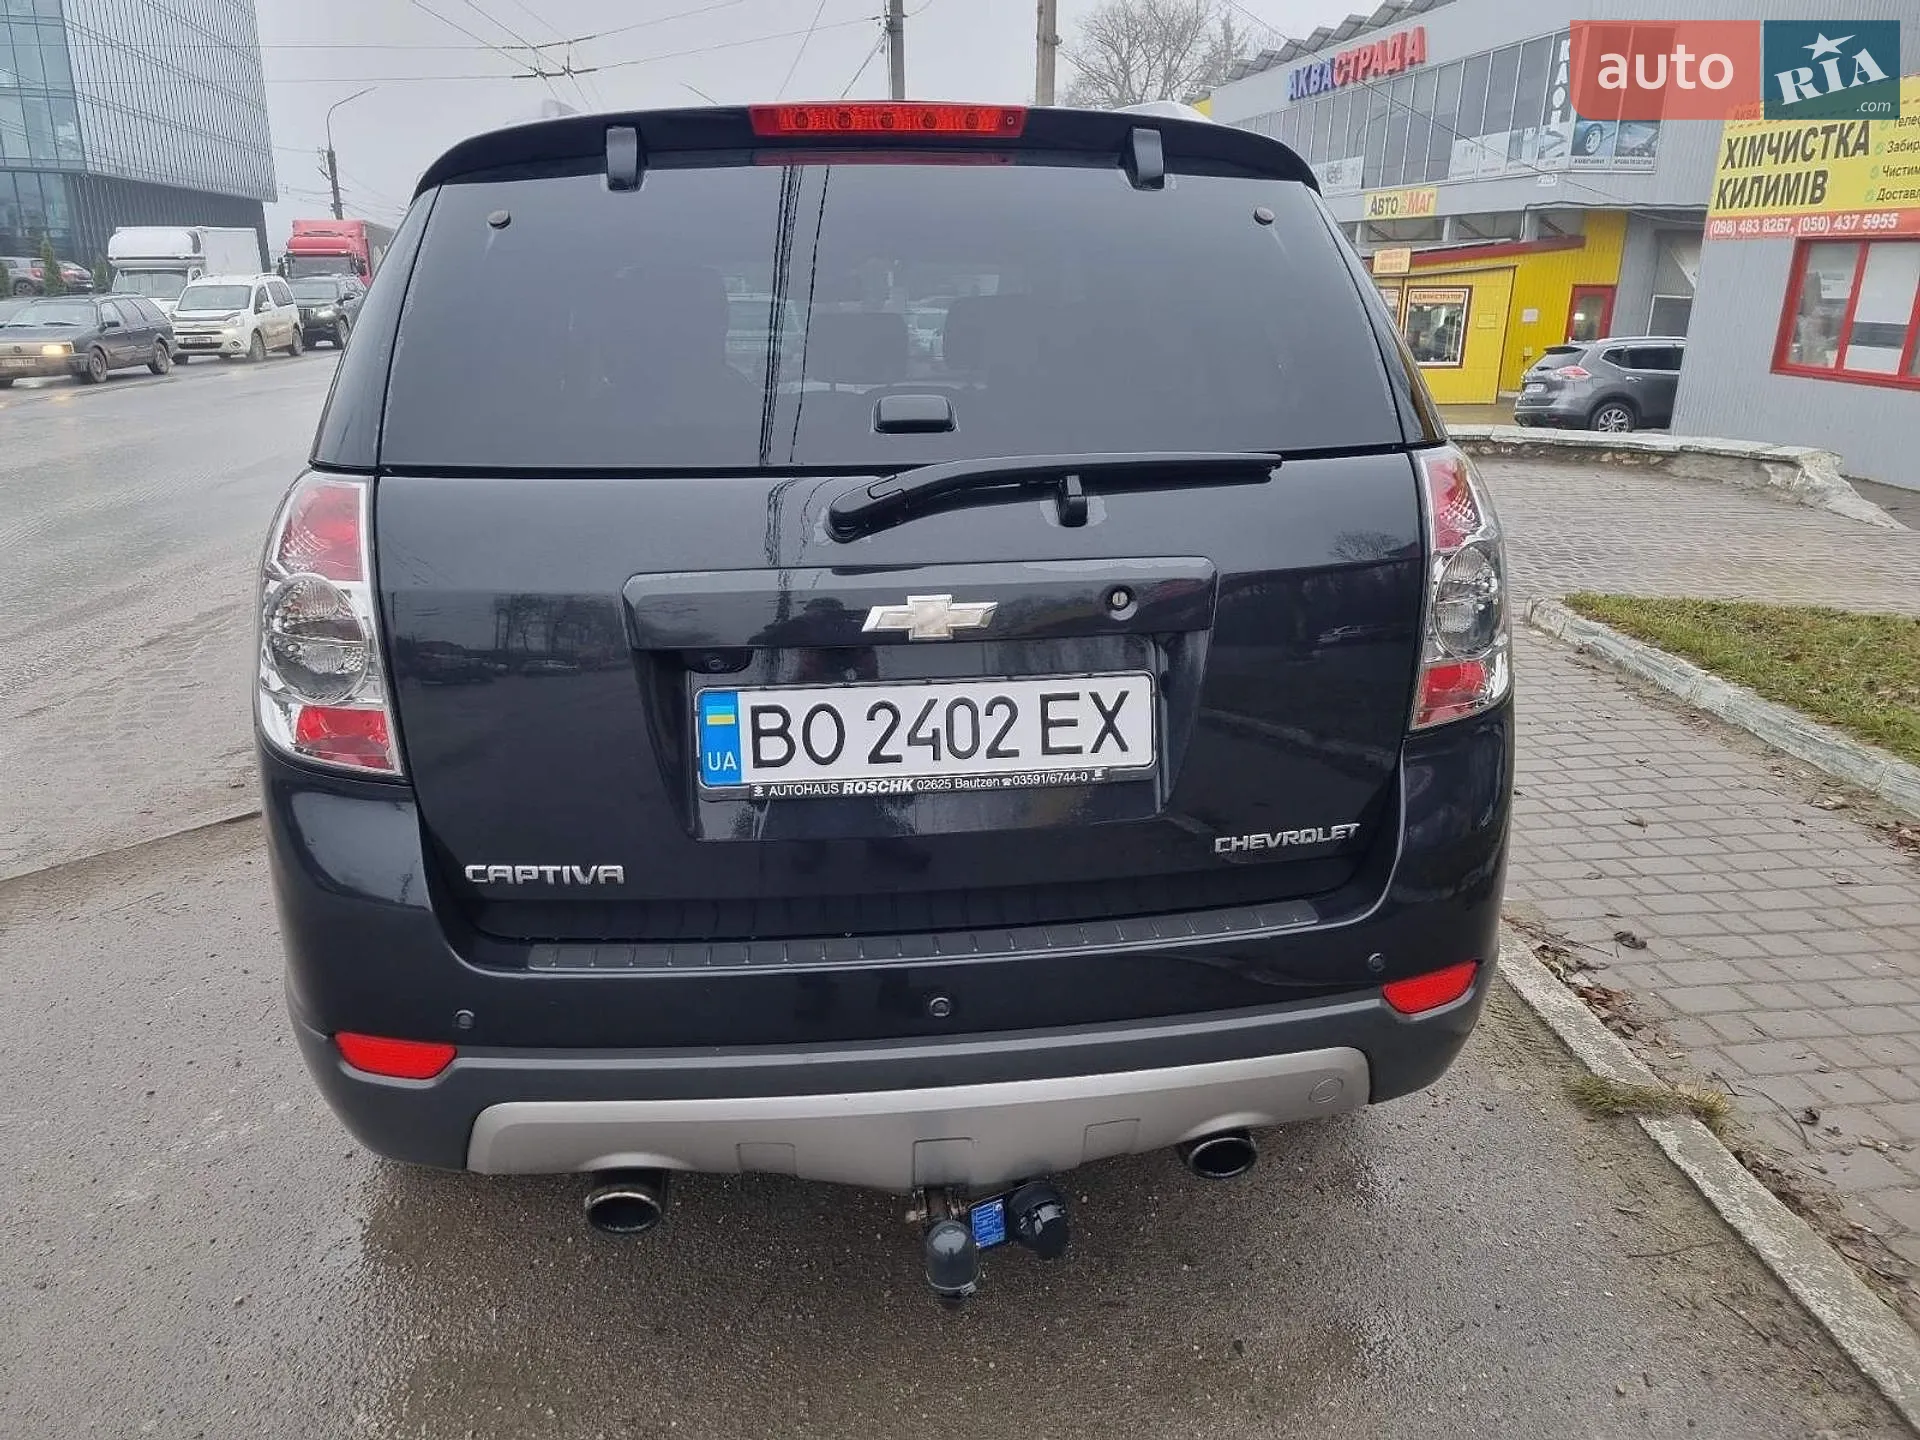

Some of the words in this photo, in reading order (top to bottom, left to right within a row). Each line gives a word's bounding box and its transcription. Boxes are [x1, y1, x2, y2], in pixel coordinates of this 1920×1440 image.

[1289, 26, 1426, 100] АКВАСТРАДА
[1722, 119, 1871, 170] ХІМЧИСТКА
[1715, 170, 1829, 210] КИЛИМІВ
[1739, 220, 1760, 234] 483
[1798, 215, 1831, 234] (050)
[1834, 213, 1858, 230] 437
[1862, 212, 1899, 230] 5955
[750, 702, 846, 769] BO
[865, 695, 1020, 765] 2402
[1039, 690, 1130, 757] EX
[707, 752, 738, 772] UA
[769, 783, 840, 797] AUTOHAUS
[842, 779, 915, 795] ROSCHK
[916, 777, 952, 790] 02625
[955, 776, 1000, 789] Bautzen
[1214, 822, 1361, 853] CHEVROLET
[464, 864, 626, 885] CAPTIVA
